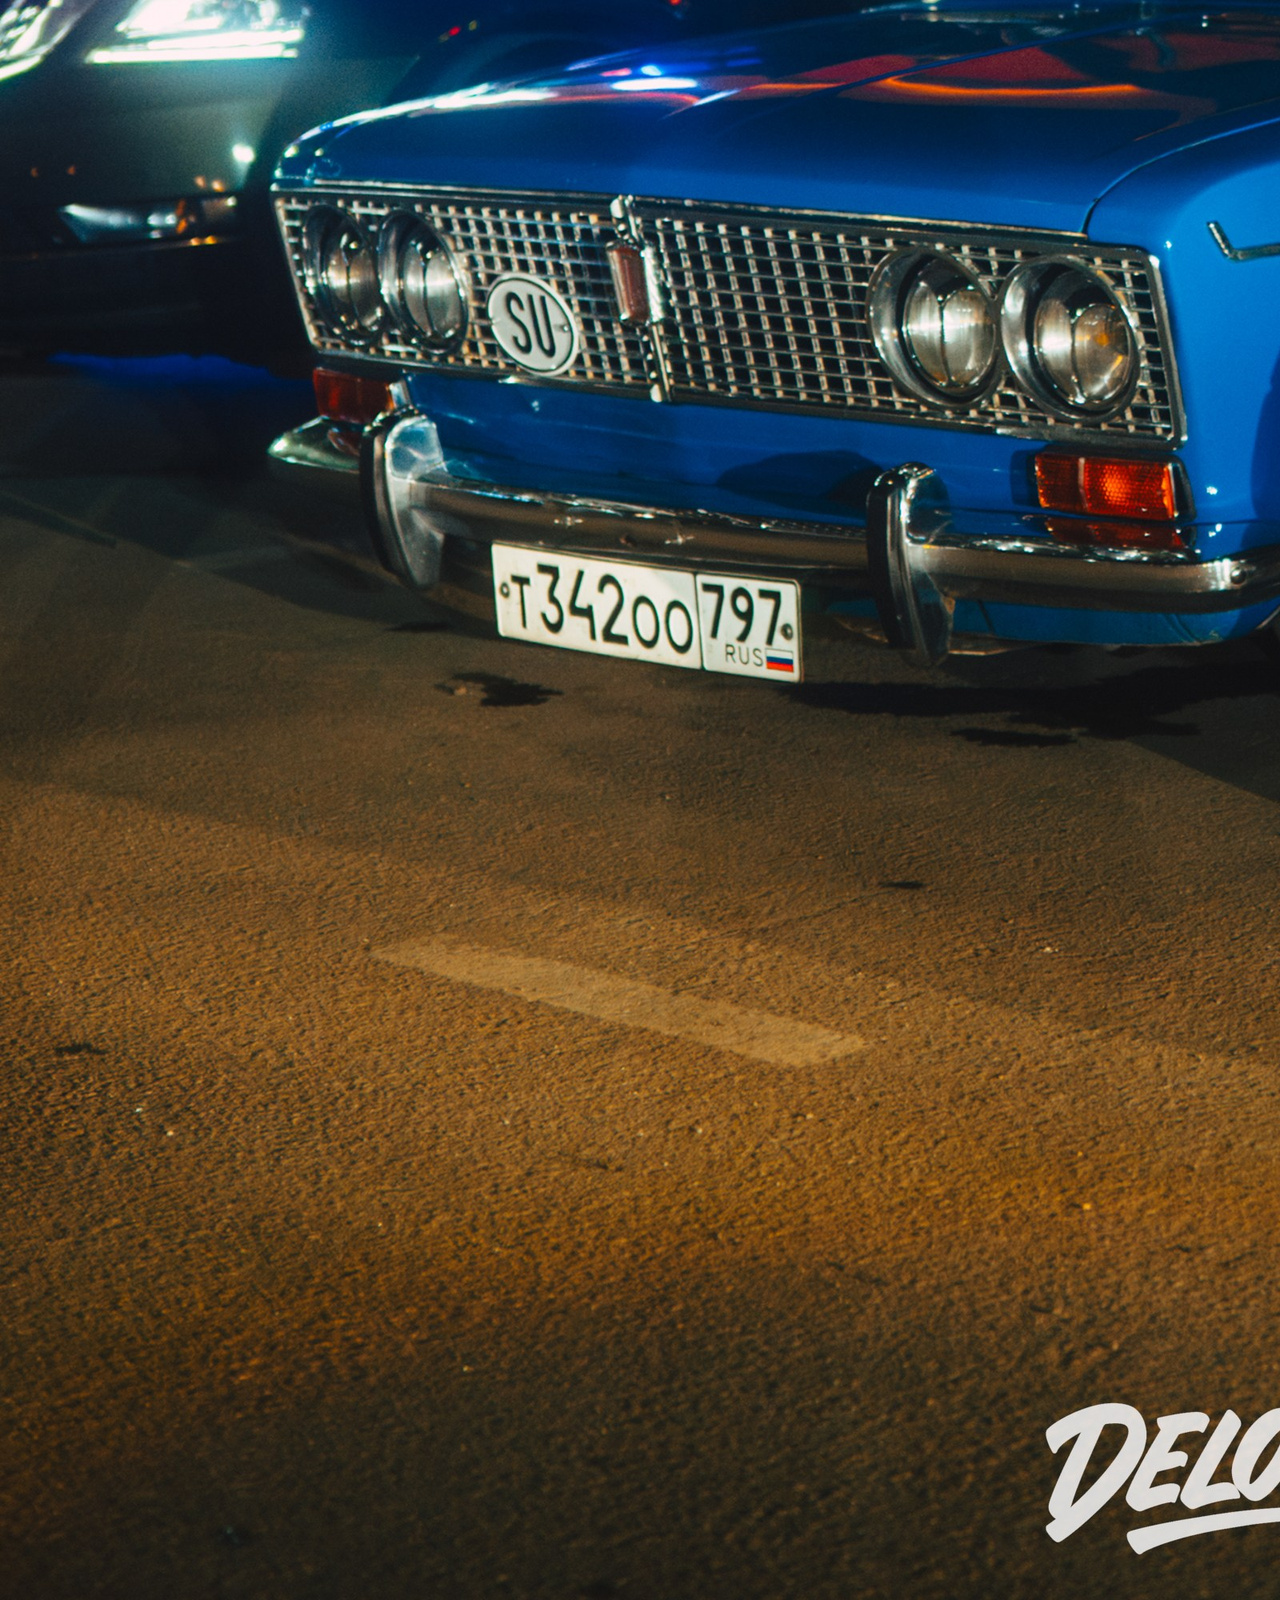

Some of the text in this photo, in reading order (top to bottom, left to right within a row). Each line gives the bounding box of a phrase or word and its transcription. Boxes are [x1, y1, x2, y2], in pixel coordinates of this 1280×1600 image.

[506, 290, 557, 359] SU
[702, 583, 782, 647] 797
[724, 643, 764, 668] RUS
